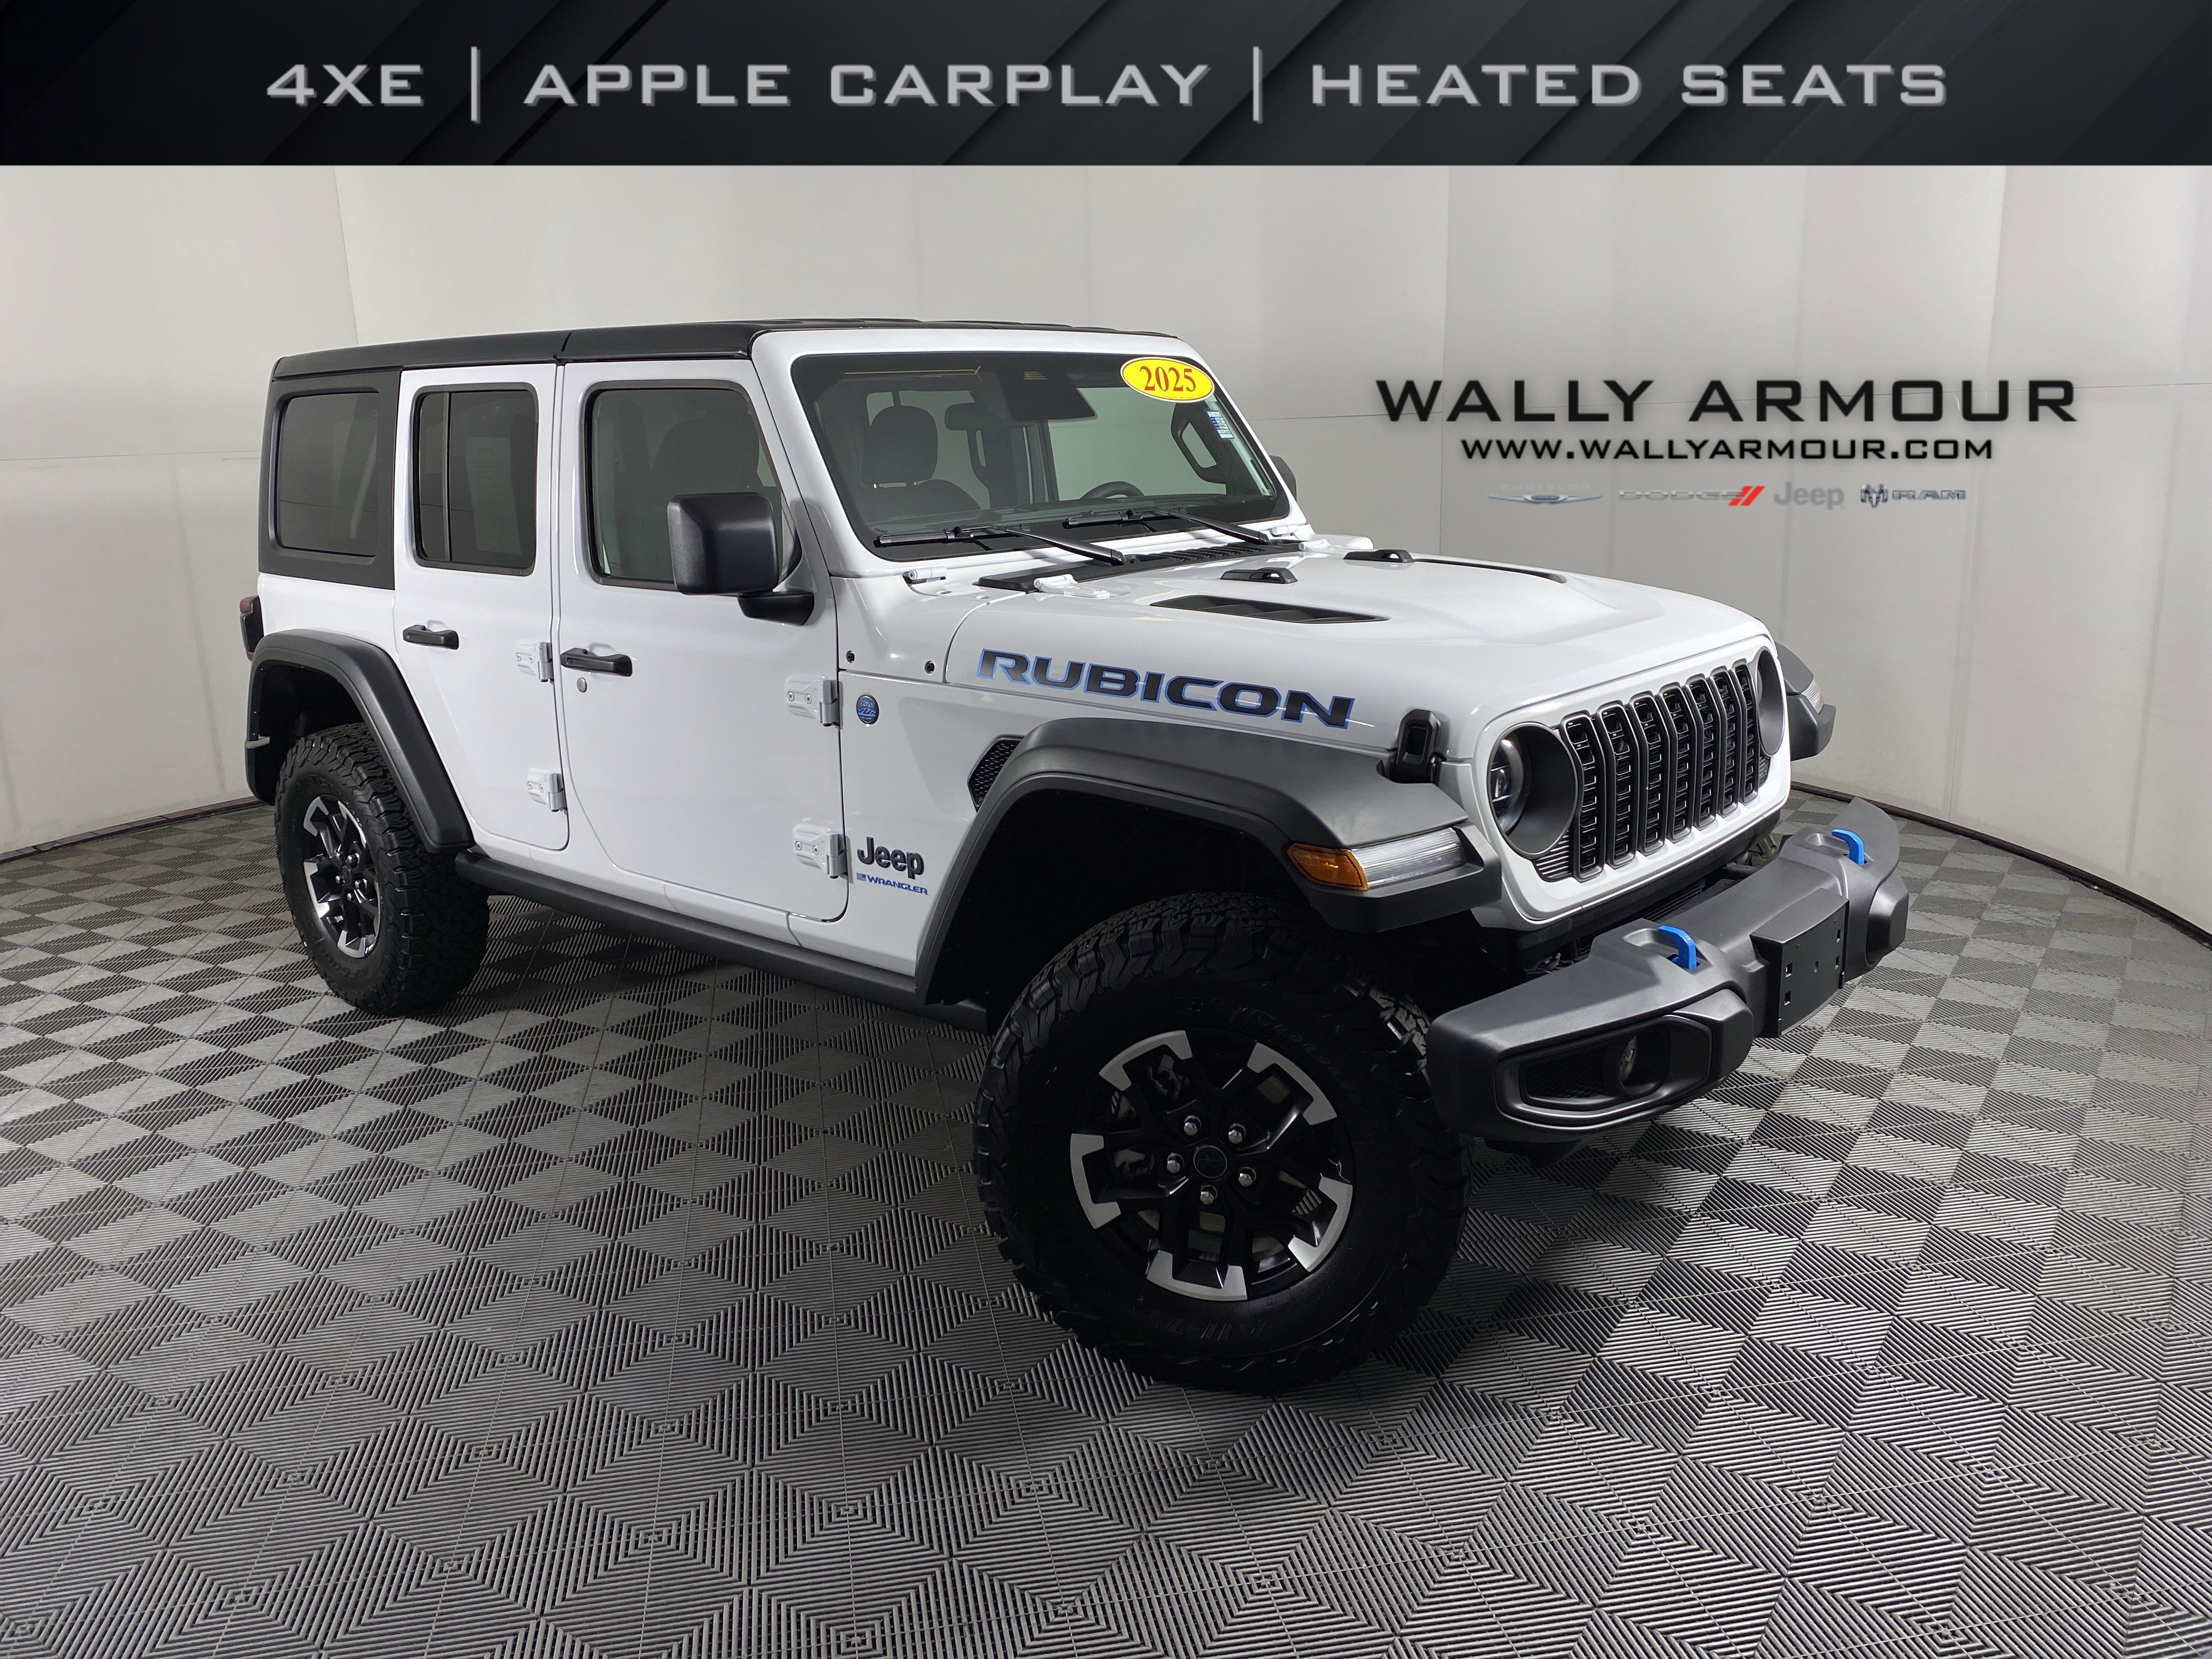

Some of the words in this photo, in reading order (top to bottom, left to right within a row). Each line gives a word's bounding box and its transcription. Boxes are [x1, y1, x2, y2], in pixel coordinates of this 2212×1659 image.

[1139, 365, 1197, 392] 2025
[976, 648, 1356, 730] RUBICON
[856, 836, 925, 880] Jeep
[866, 874, 929, 895] WRANGLER
